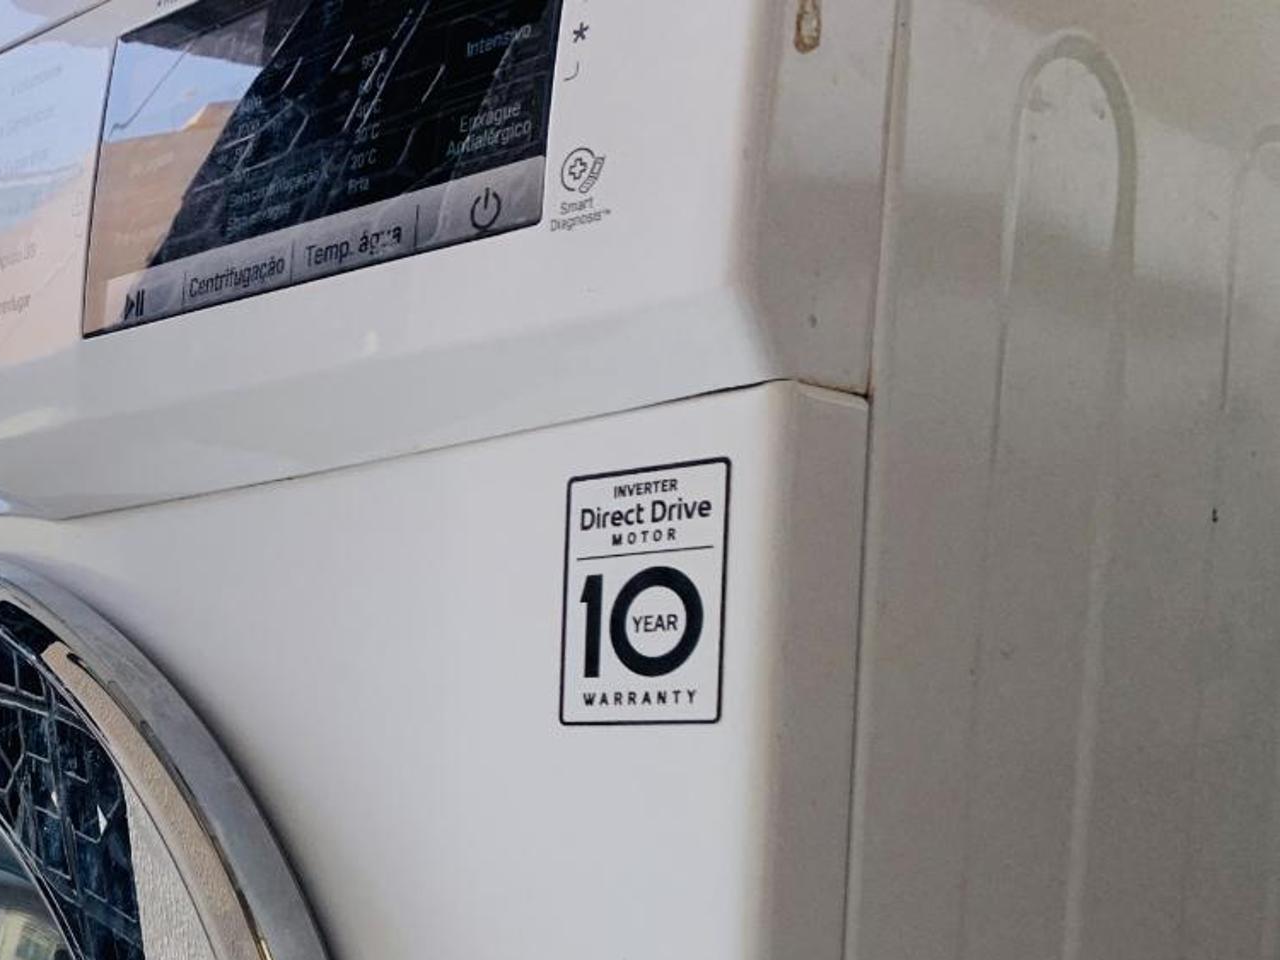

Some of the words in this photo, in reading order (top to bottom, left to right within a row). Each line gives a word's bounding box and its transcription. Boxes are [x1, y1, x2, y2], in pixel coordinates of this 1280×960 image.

[614, 478, 679, 499] INVERTER
[580, 502, 645, 531] Direct
[651, 497, 713, 523] Drive
[611, 527, 677, 546] MOTOR
[580, 565, 704, 678] 10
[632, 614, 679, 634] YEAR
[583, 689, 699, 708] WARRANTY
